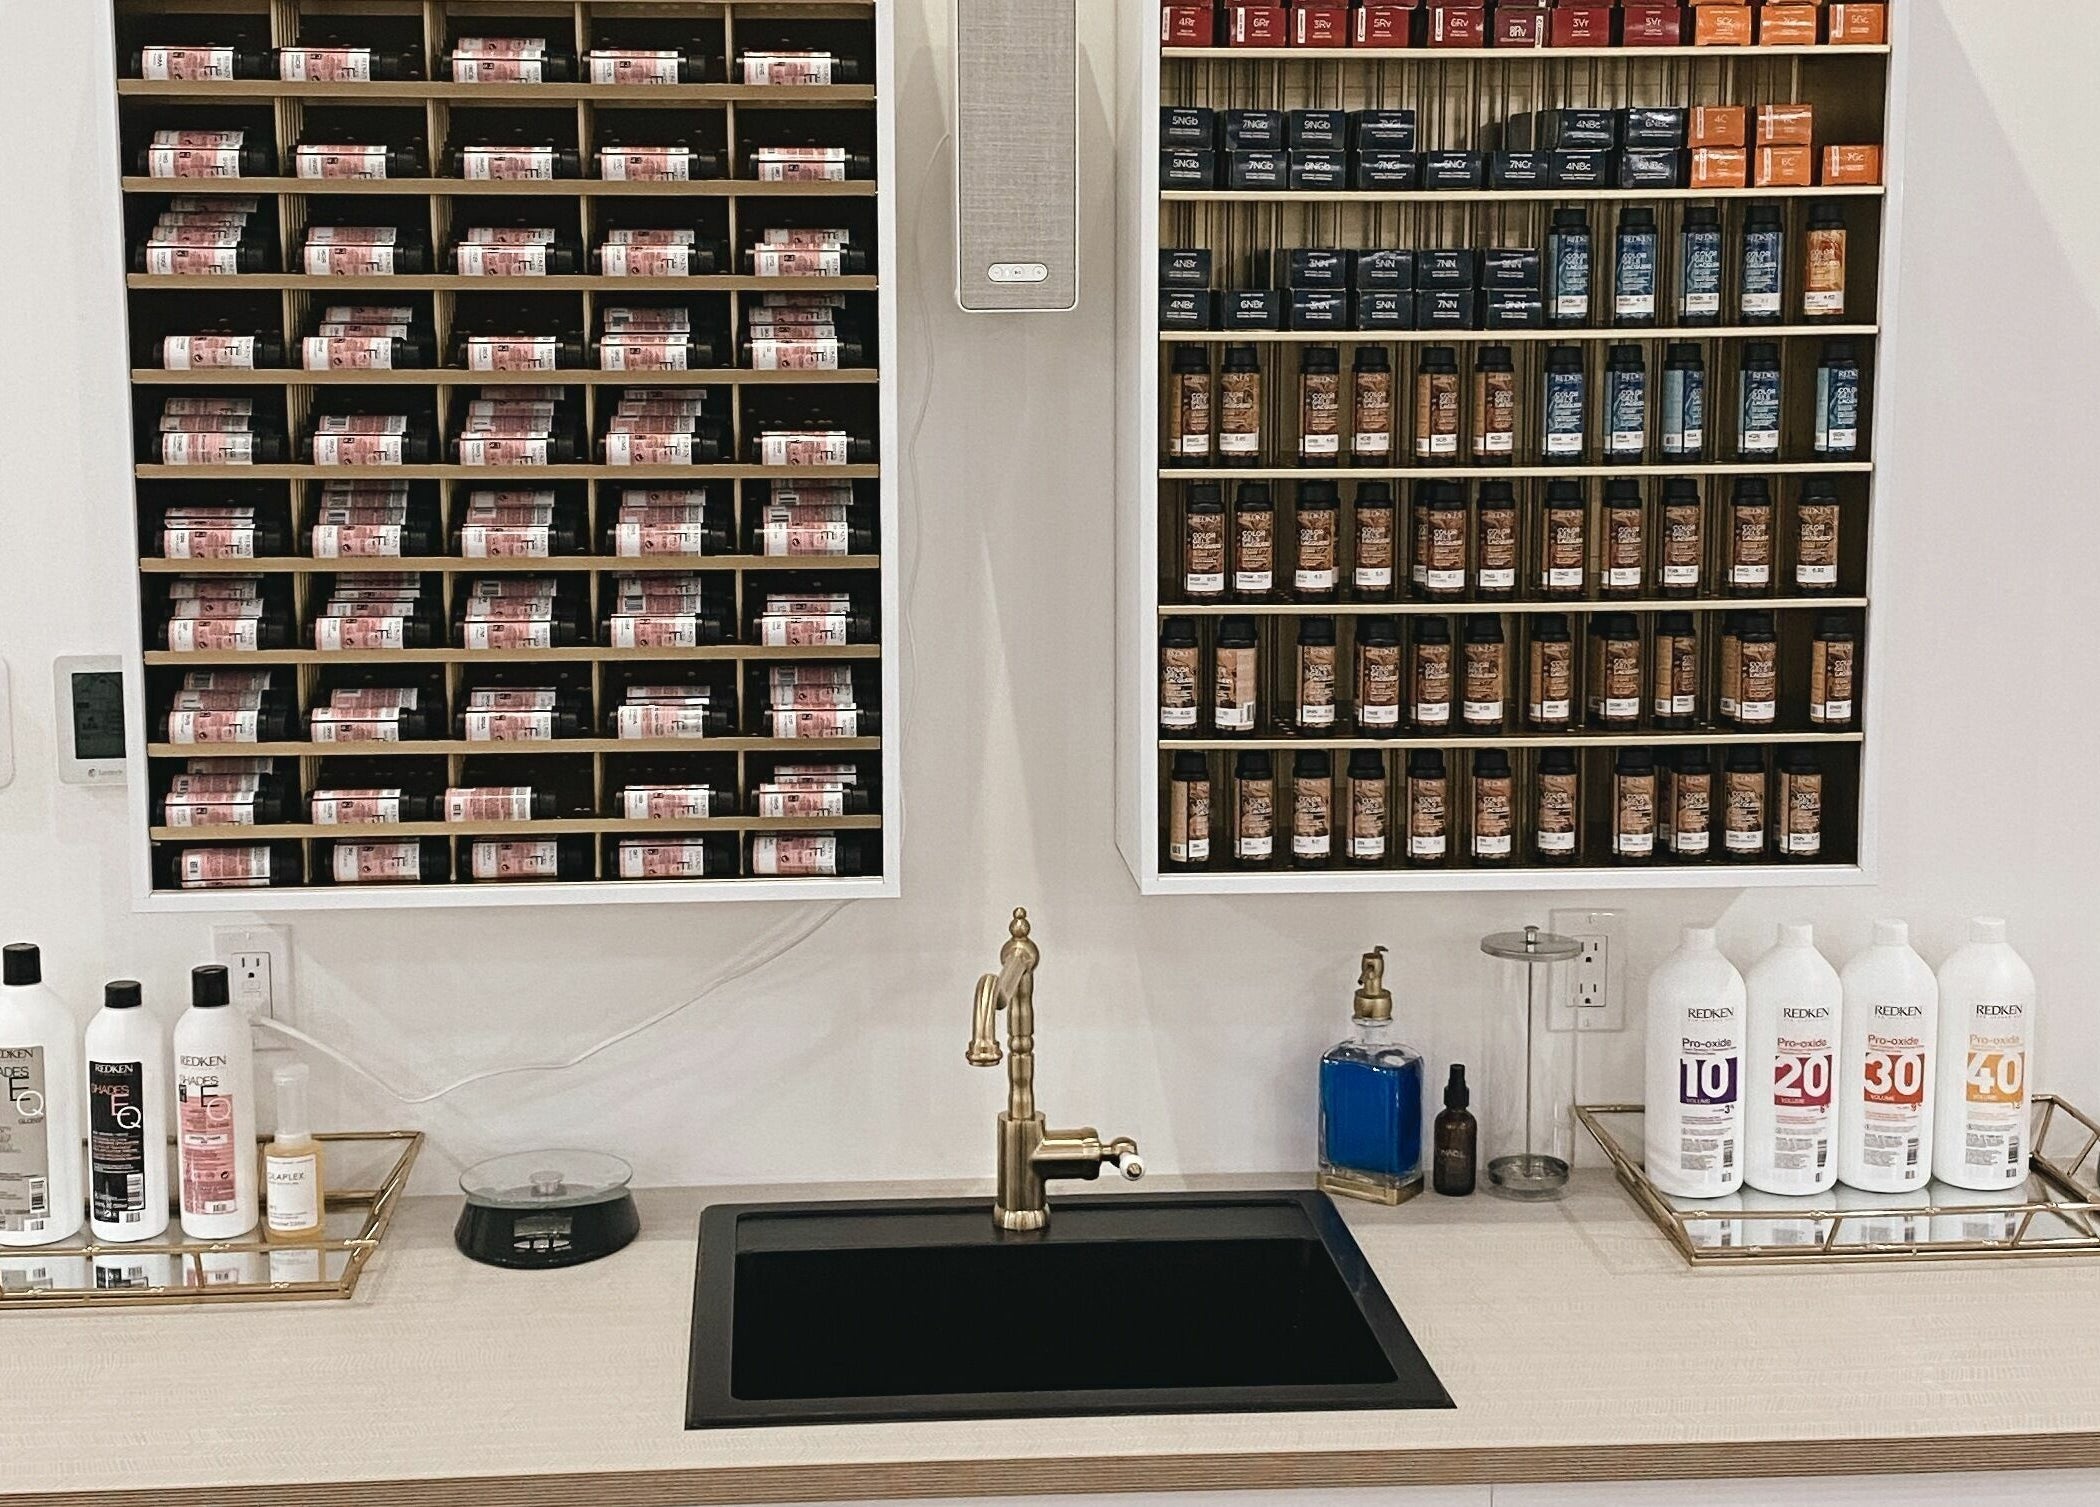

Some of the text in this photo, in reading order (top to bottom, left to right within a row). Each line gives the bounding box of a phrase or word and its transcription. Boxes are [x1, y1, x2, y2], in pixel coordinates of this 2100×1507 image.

[1172, 116, 1199, 126] 5NGb
[1242, 119, 1268, 129] 7NGb
[1303, 120, 1331, 130] 9NGb
[1172, 159, 1200, 169] 5NGb
[1248, 160, 1274, 171] 7NGb
[1375, 259, 1396, 268] 5NN
[1436, 259, 1457, 268] 7NN
[1375, 300, 1396, 309] 5NN
[1437, 300, 1458, 309] 7NN
[1688, 1007, 1734, 1019] REDKEN
[1783, 1007, 1830, 1019] REDKEN
[1874, 1005, 1922, 1017] REDKEN
[1976, 1004, 2023, 1016] REDKEN
[1682, 1037, 1732, 1048] Pro-oxide
[1777, 1037, 1827, 1048] Pro-oxide
[1868, 1034, 1919, 1046] Pro-oxide
[1969, 1034, 2020, 1046] Pro-oxide
[0, 1048, 33, 1059] DKEN
[180, 1055, 227, 1067] REDKEN
[0, 1066, 29, 1078] ADES
[95, 1063, 133, 1075] REDKEN
[1865, 1051, 1922, 1096] 30
[1967, 1050, 2022, 1096] 40
[179, 1074, 220, 1086] SHADES
[1682, 1056, 1730, 1099] 10
[1775, 1054, 1830, 1098] 20
[91, 1083, 130, 1096] SHADES
